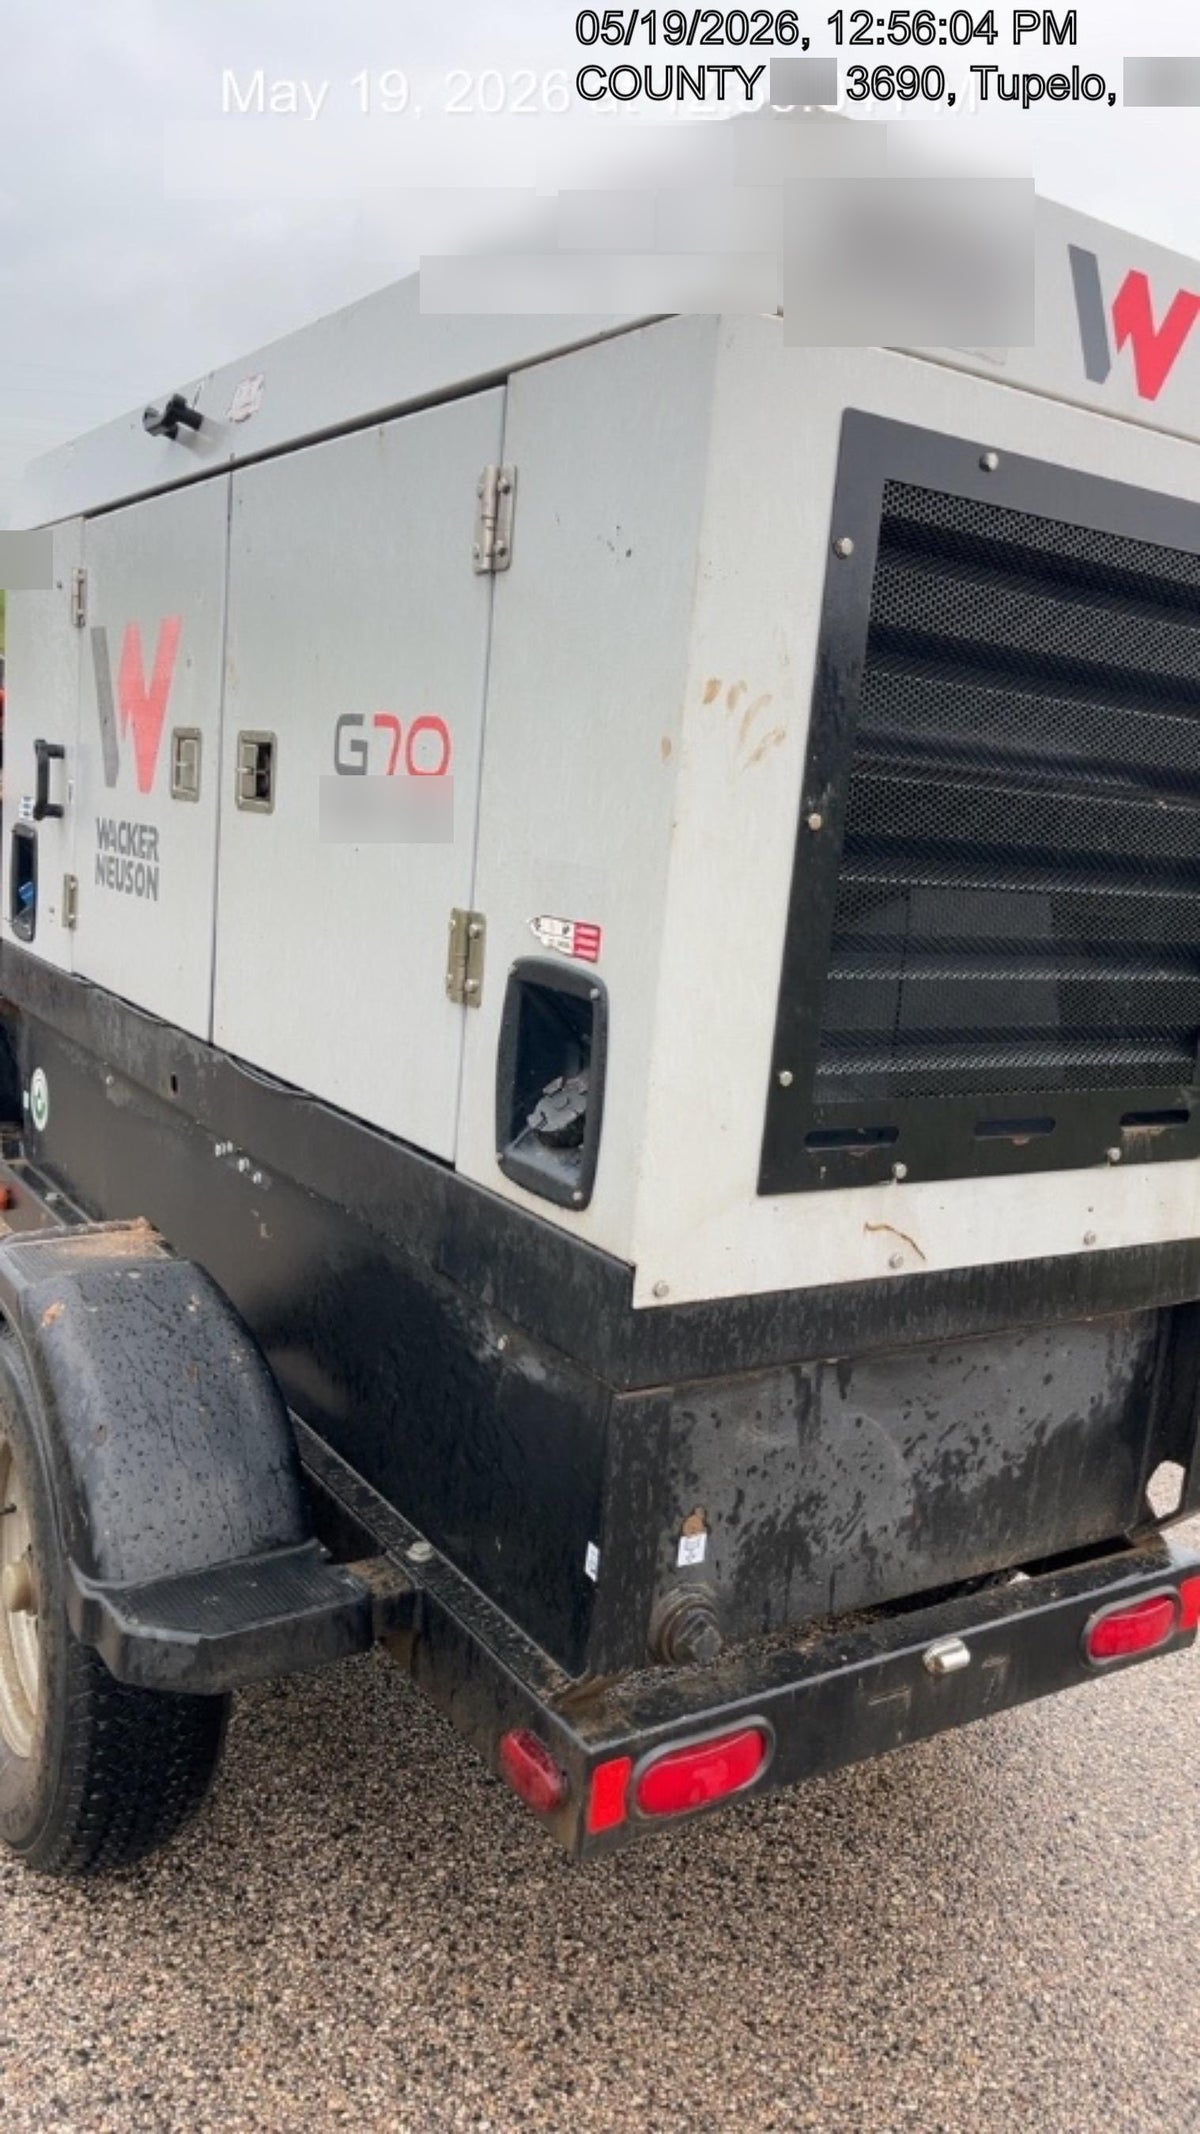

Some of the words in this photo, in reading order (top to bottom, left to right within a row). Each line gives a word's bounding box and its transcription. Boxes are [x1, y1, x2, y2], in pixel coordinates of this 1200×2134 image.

[334, 713, 451, 776] G70
[95, 817, 159, 862] WACKER
[95, 853, 159, 901] NEUSON
